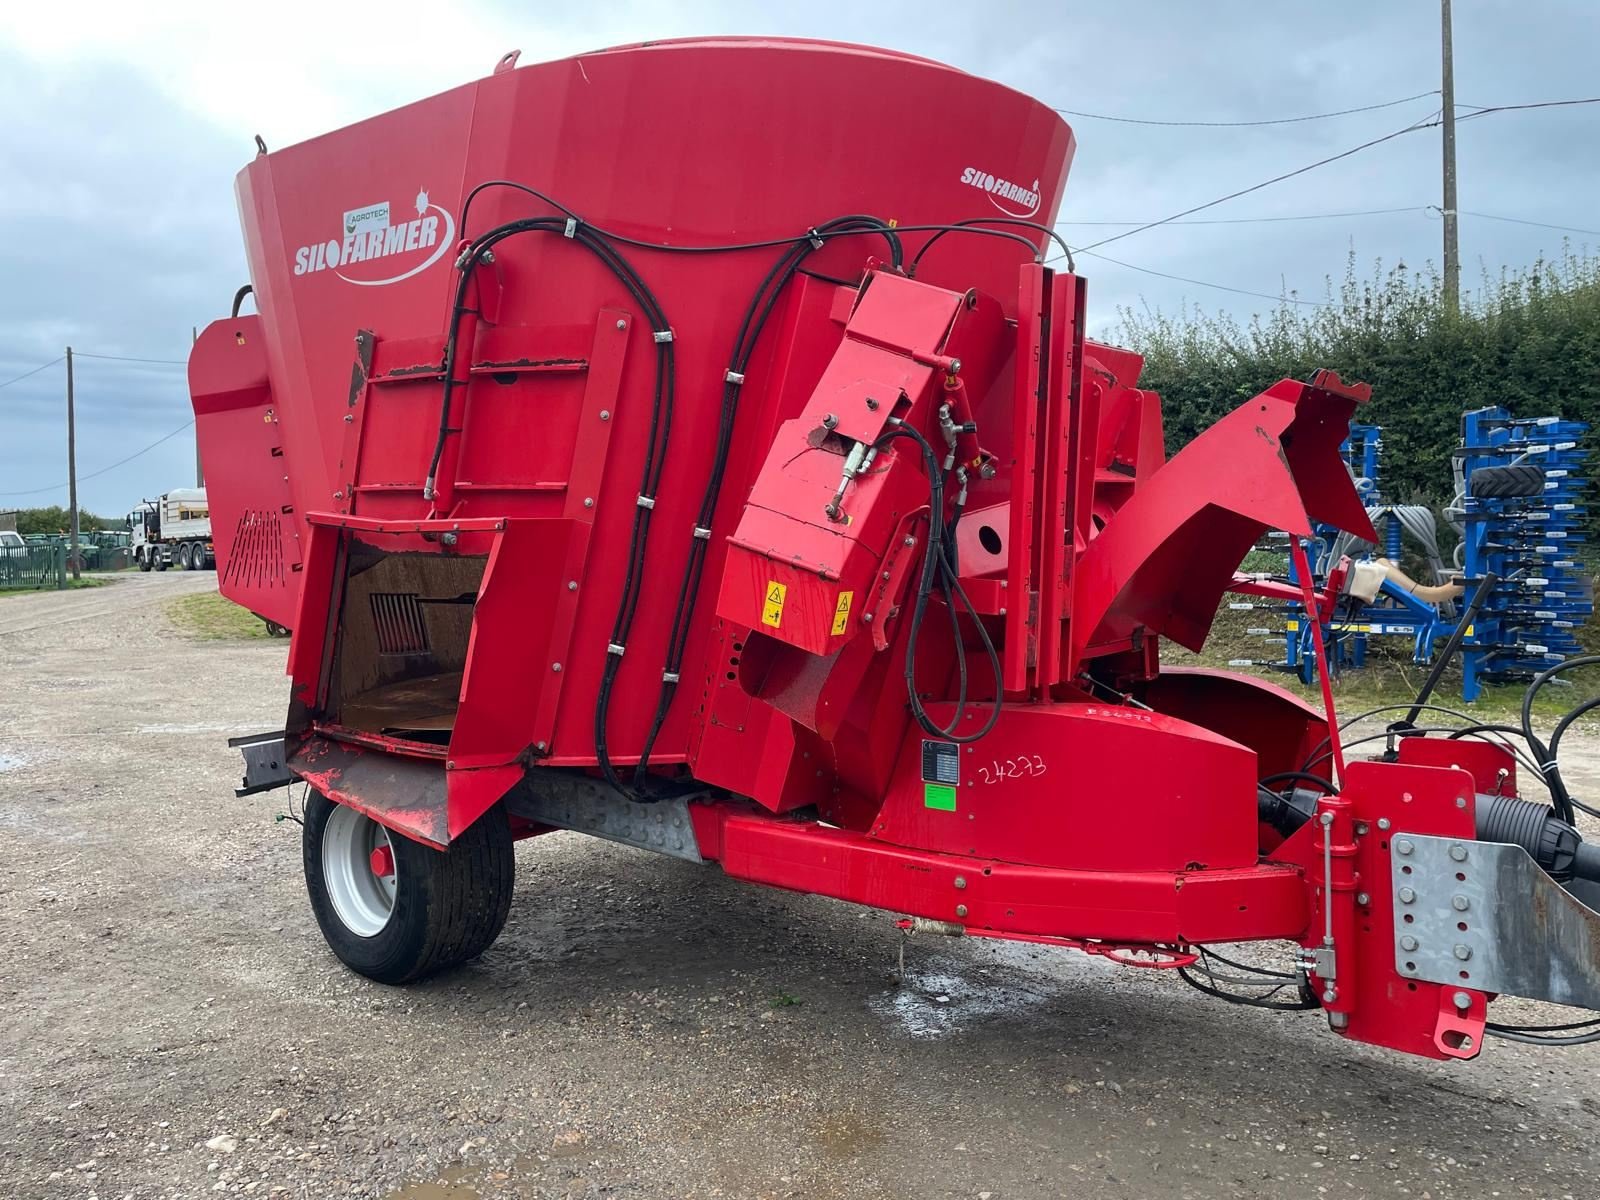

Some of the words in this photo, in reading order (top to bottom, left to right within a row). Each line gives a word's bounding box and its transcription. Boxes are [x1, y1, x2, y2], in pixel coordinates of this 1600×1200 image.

[961, 167, 1038, 208] SILOFARMER
[351, 208, 389, 223] AGROTECH
[979, 755, 1047, 784] 24273
